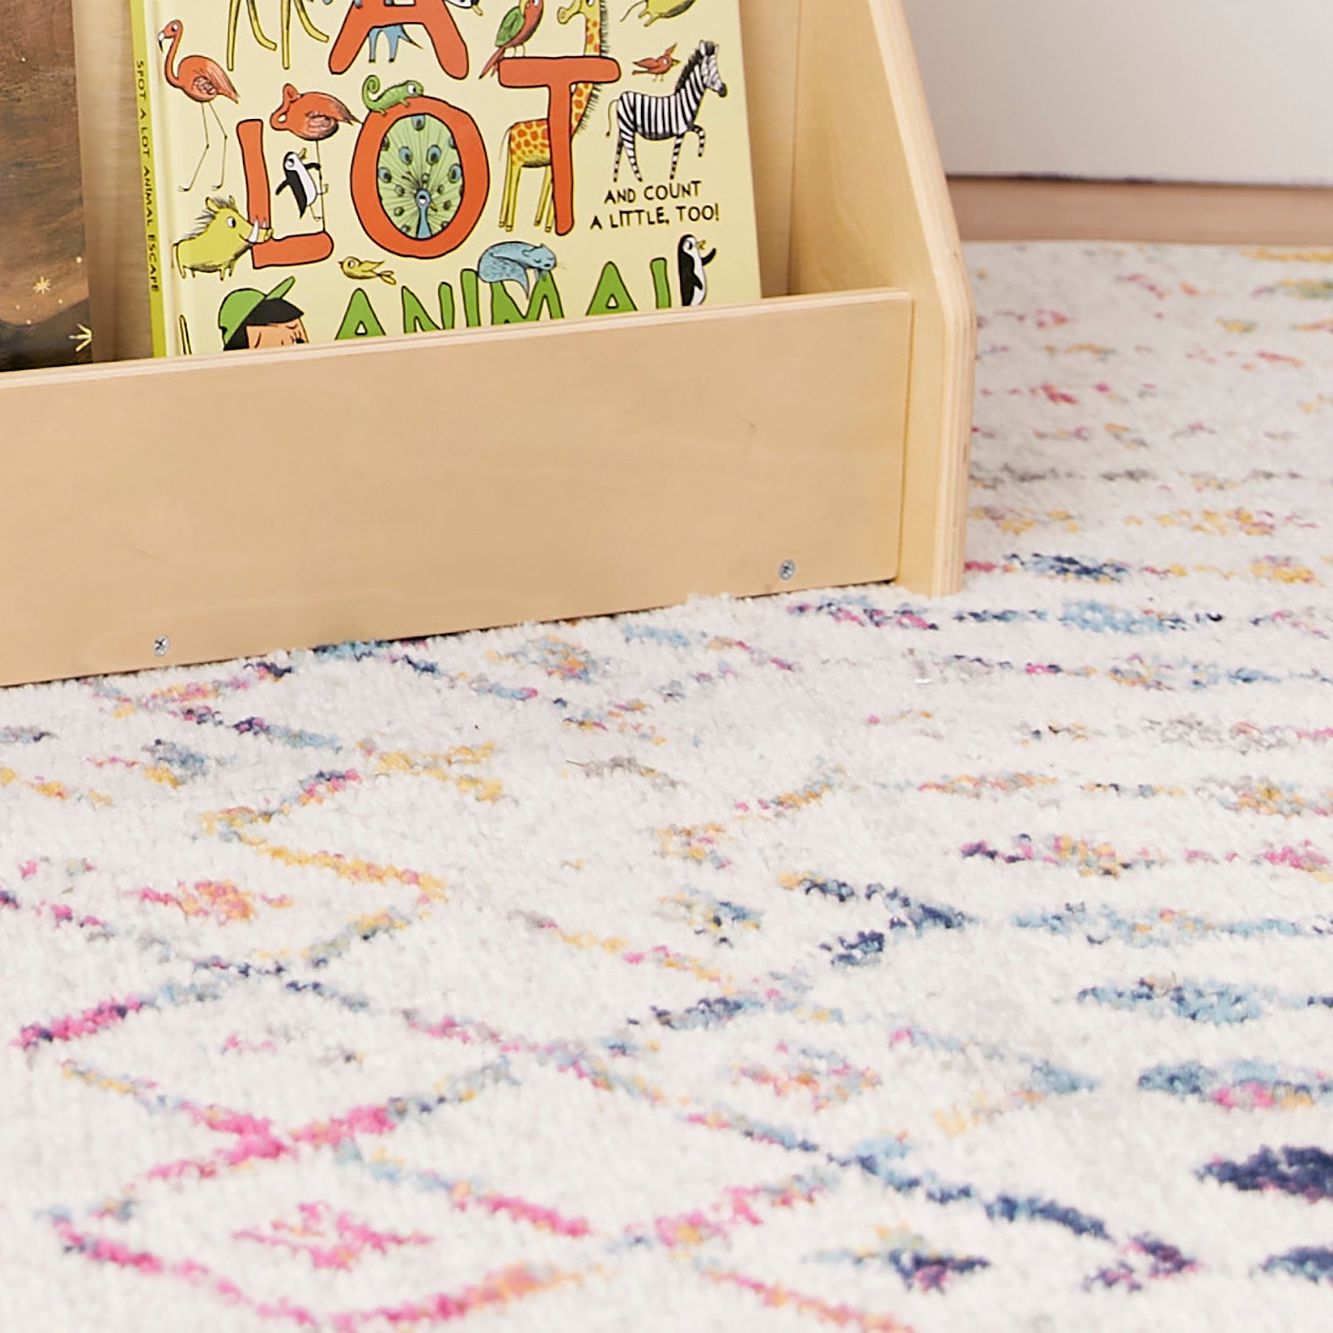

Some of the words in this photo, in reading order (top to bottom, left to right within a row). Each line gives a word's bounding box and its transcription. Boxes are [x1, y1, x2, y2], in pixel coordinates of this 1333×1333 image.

[136, 60, 147, 101] SPOT
[139, 108, 147, 119] A
[141, 126, 150, 158] LOT
[235, 55, 621, 269] LOT
[143, 165, 153, 227] ANIMAL
[604, 188, 636, 204] AND
[644, 180, 701, 200] COUNT
[590, 215, 603, 229] A
[676, 202, 720, 221] TOO!
[148, 234, 160, 293] ESCAPE
